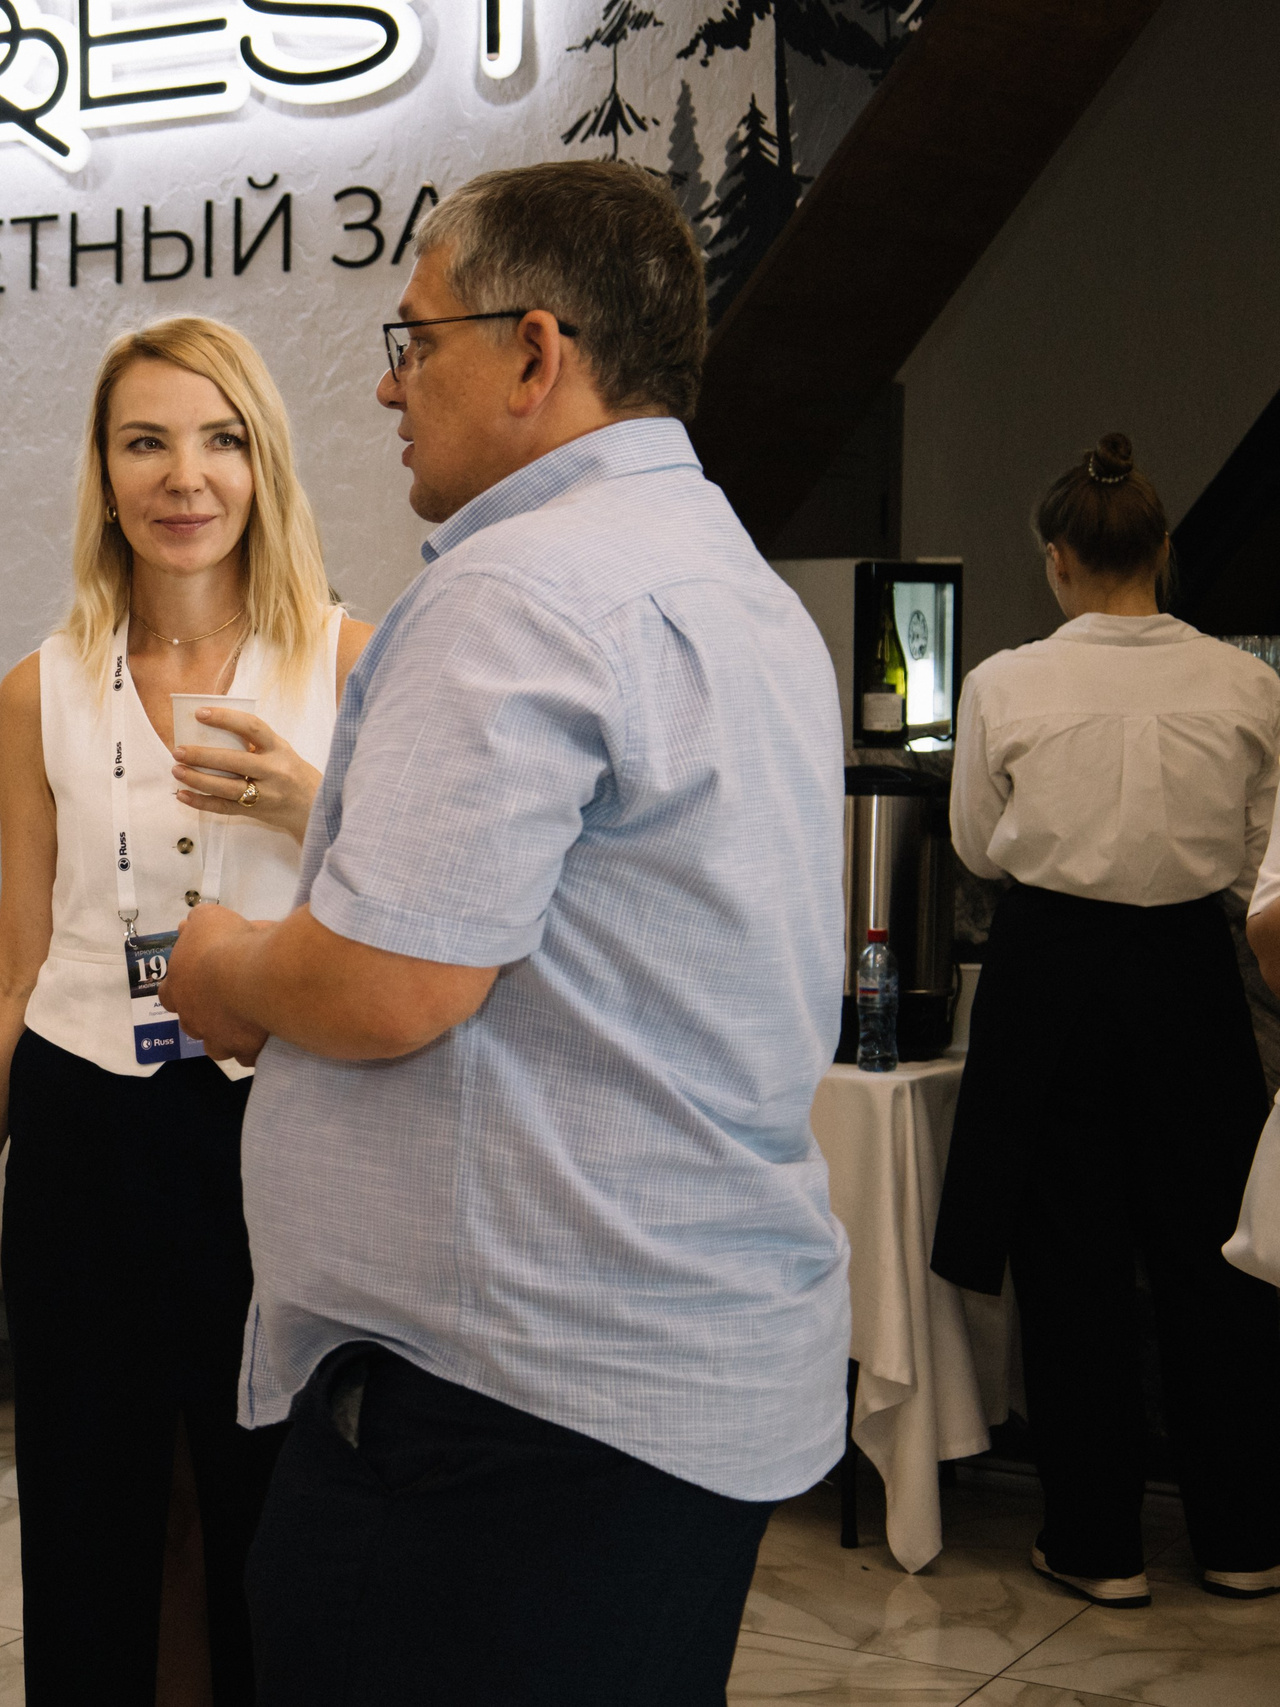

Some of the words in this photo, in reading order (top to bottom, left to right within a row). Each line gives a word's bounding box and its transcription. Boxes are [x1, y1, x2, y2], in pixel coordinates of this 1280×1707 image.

[331, 184, 440, 269] ЗА
[114, 655, 123, 677] Russ
[114, 741, 123, 764] Russ
[118, 831, 128, 856] Russ
[134, 947, 165, 957] ИРКУТСК
[135, 954, 168, 983] 19
[153, 1037, 175, 1047] Russ
